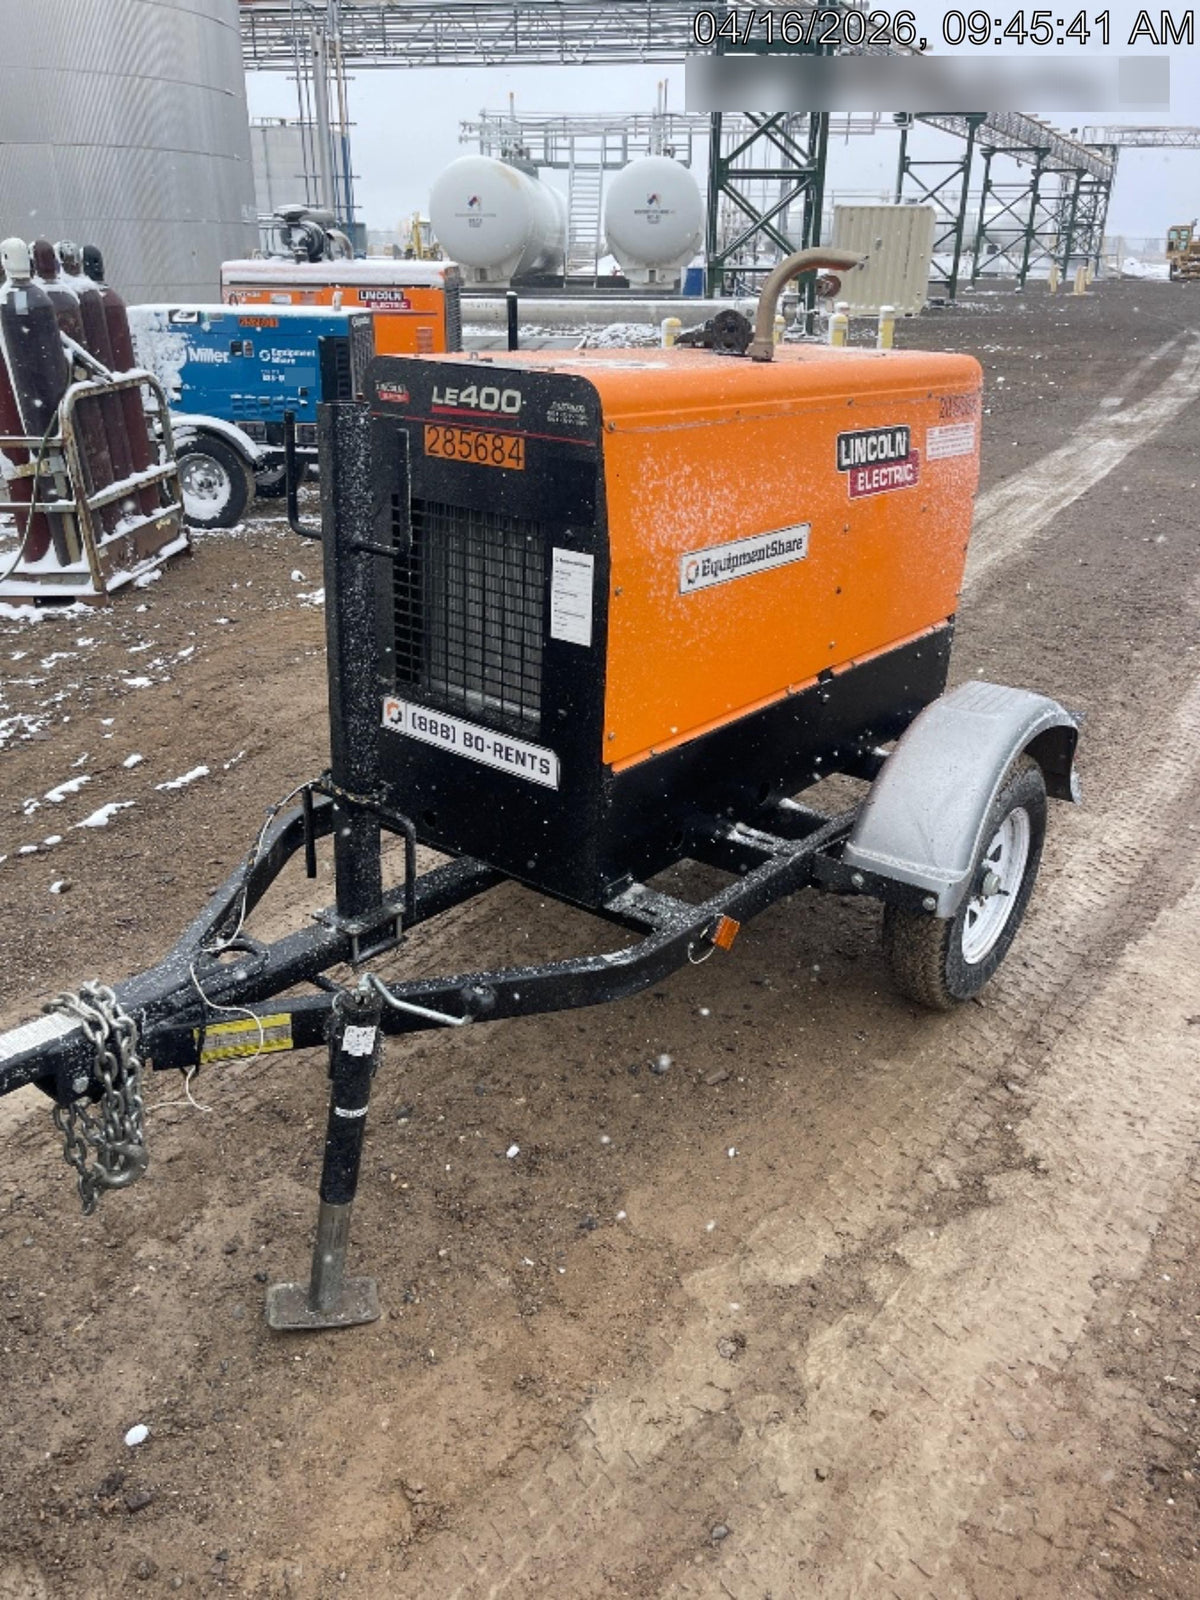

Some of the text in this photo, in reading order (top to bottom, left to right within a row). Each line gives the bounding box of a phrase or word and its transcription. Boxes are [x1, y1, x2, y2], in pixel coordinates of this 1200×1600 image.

[187, 346, 229, 363] Miller
[432, 385, 522, 413] LE400
[427, 426, 523, 467] 285684
[840, 430, 907, 466] LINCOLN
[857, 463, 914, 492] ELECTRIC
[701, 537, 804, 577] EquipmentShare
